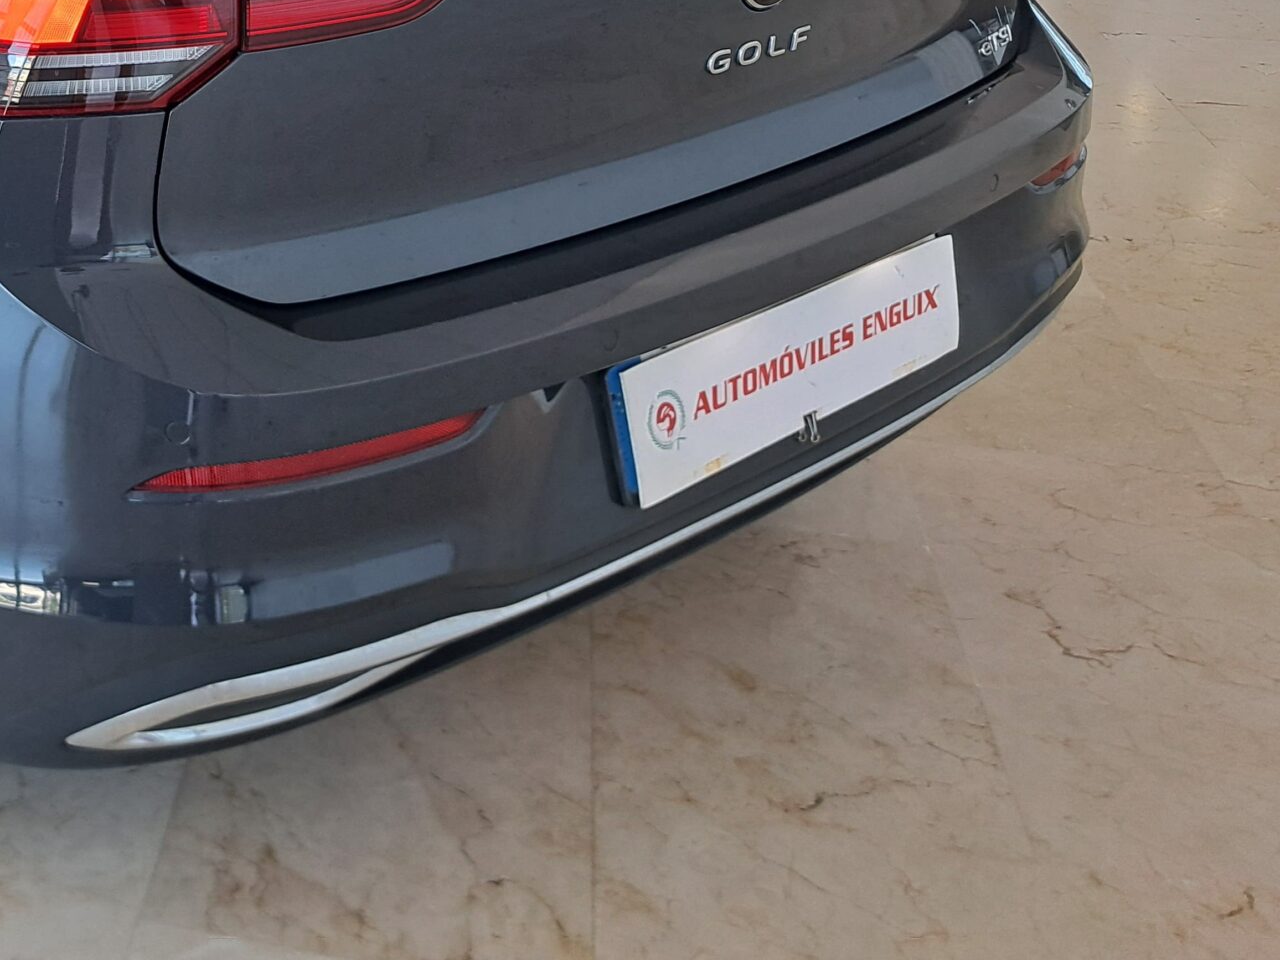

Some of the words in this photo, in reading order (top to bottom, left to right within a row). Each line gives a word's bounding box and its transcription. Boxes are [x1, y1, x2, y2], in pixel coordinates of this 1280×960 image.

[706, 24, 812, 75] GOLF
[693, 322, 854, 420] AUTOMÓVILES
[862, 283, 940, 341] ENGUIX
